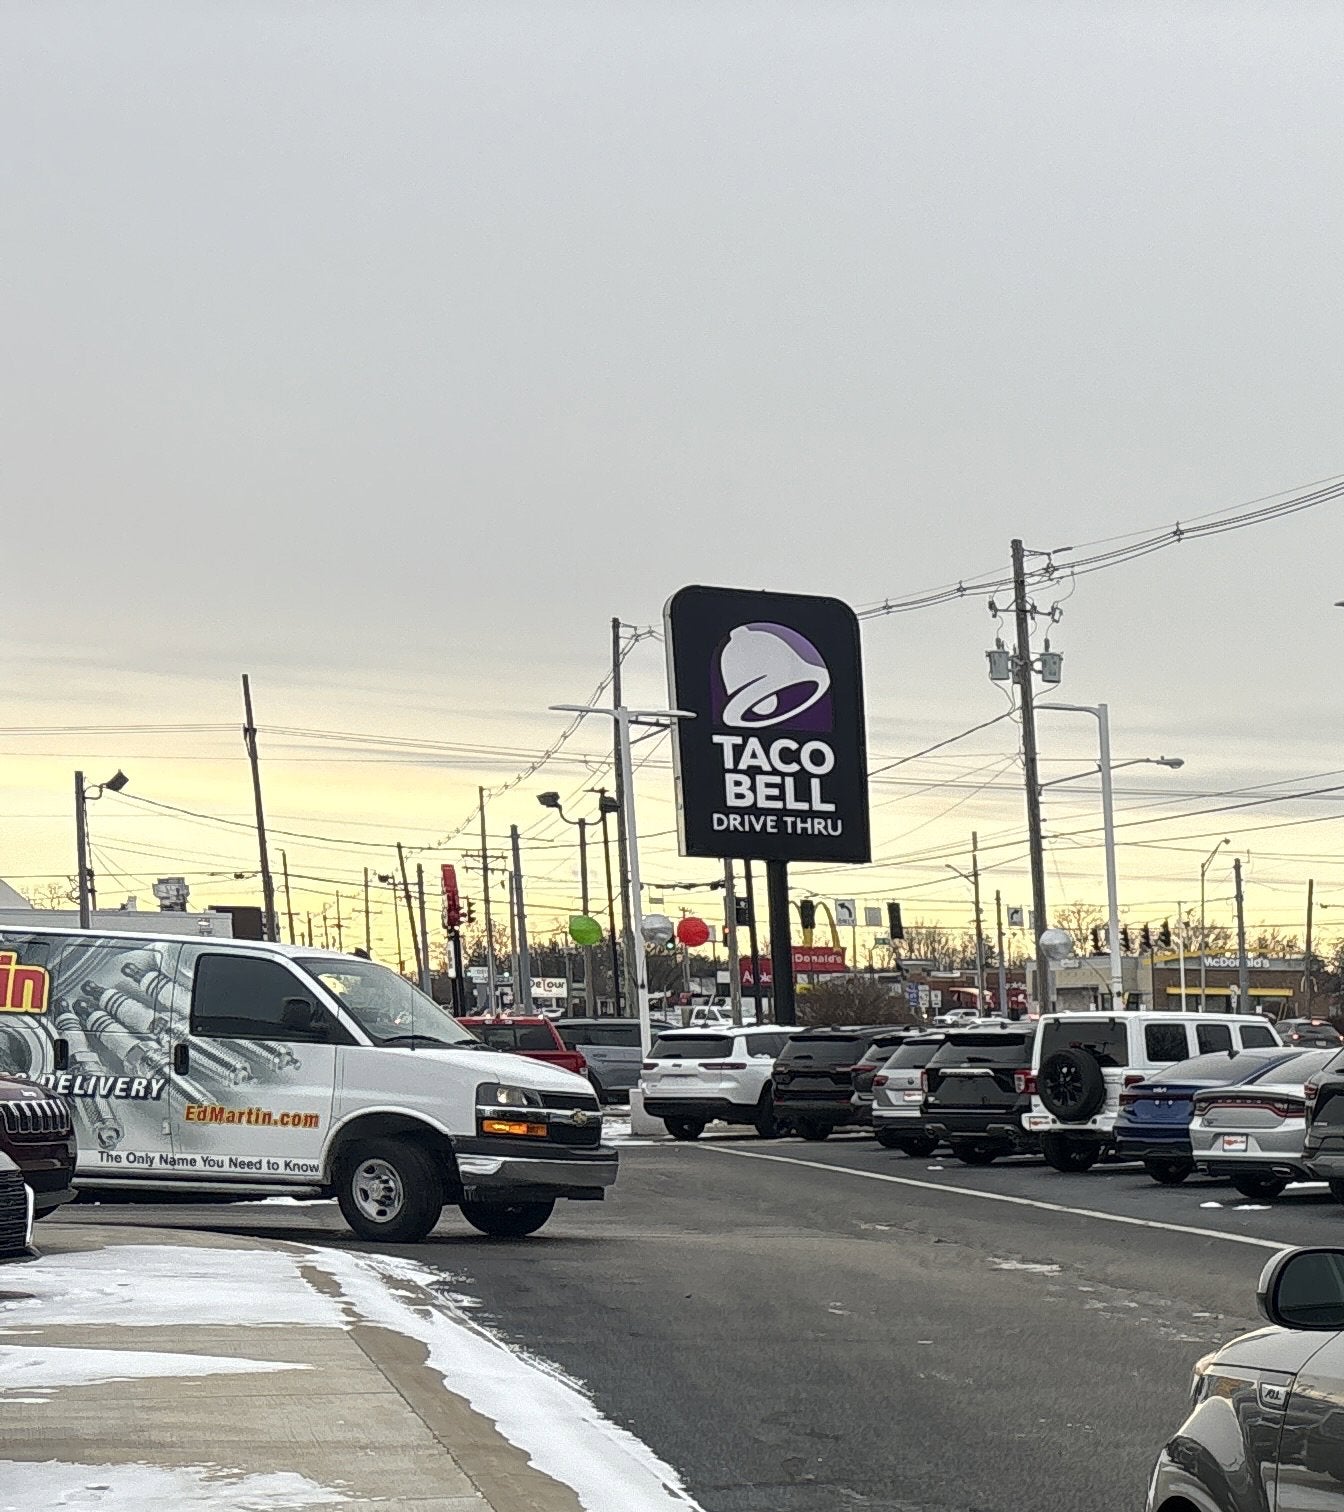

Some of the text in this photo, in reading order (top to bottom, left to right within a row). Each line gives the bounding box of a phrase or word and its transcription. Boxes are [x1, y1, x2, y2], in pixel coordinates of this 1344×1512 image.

[712, 734, 835, 775] TACO
[724, 772, 836, 812] BELL
[712, 812, 843, 836] DRIVE THRU
[184, 1103, 321, 1129] EdMartin.com
[98, 1151, 122, 1164] The
[126, 1152, 154, 1167] Only
[159, 1153, 197, 1167] Name
[200, 1156, 224, 1169] You
[228, 1157, 262, 1171] Need
[266, 1158, 279, 1171] to
